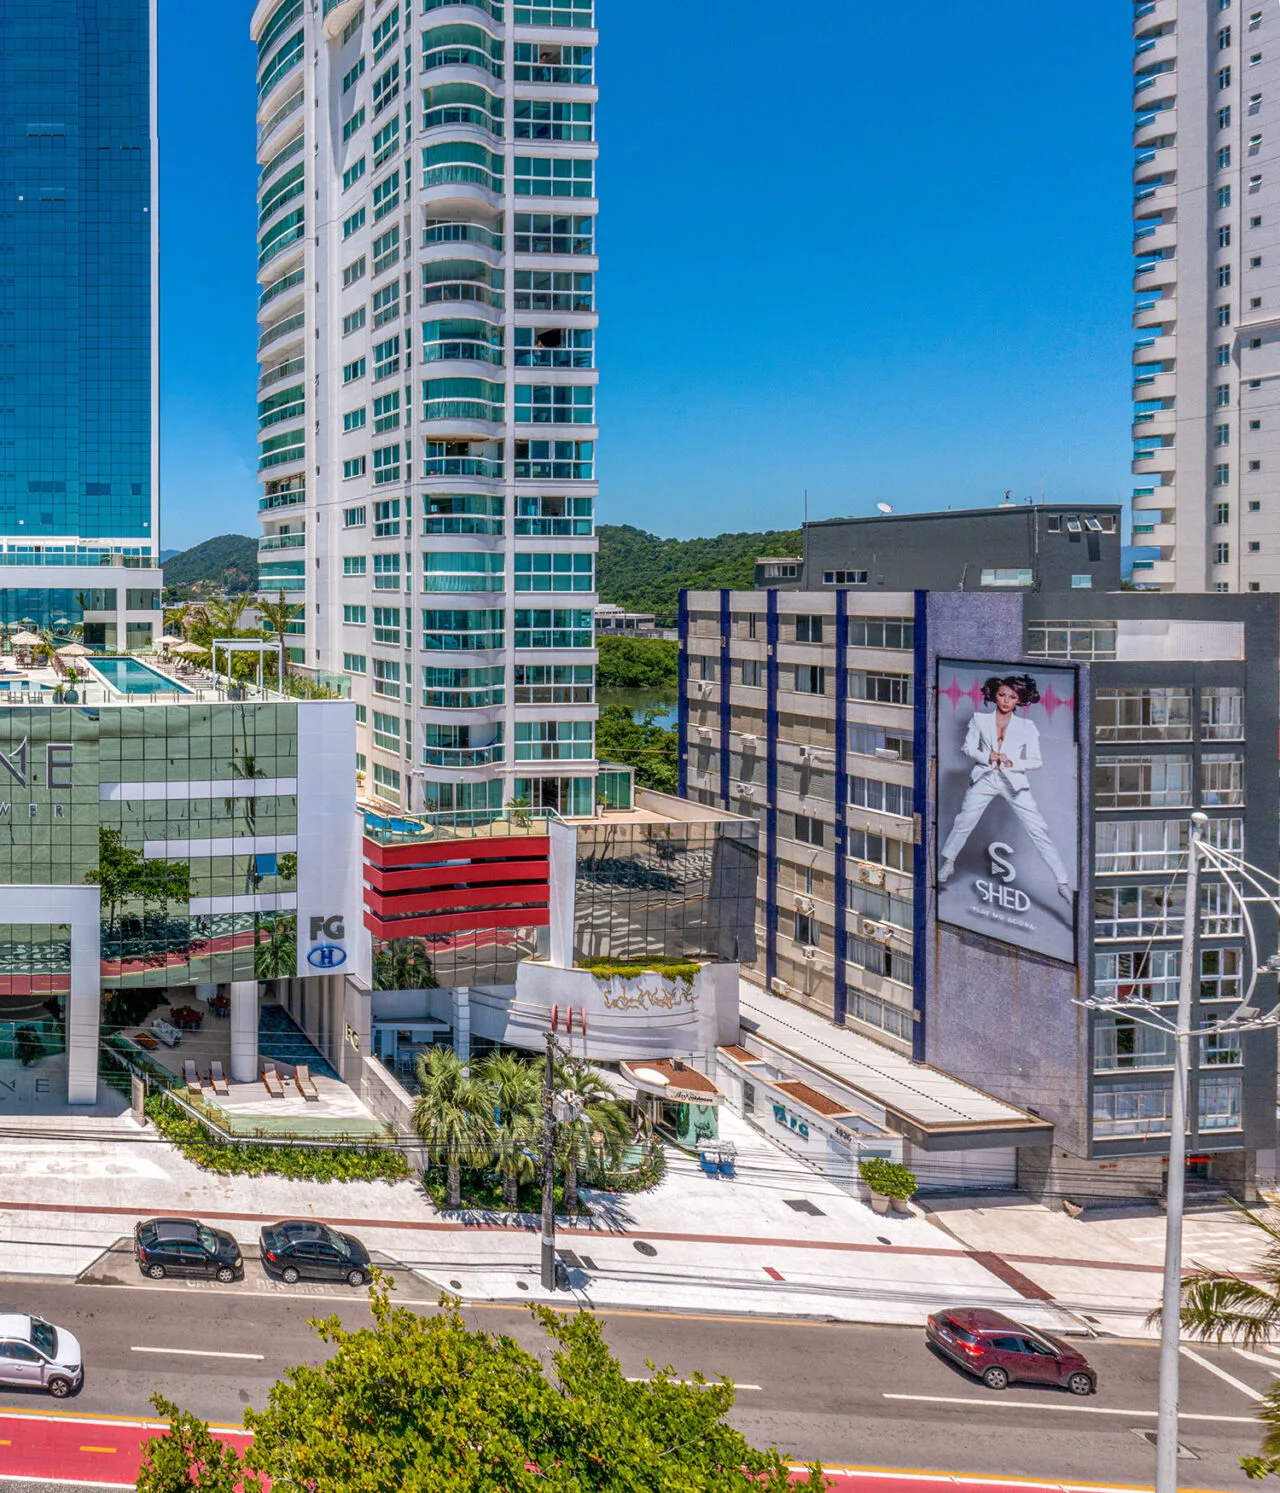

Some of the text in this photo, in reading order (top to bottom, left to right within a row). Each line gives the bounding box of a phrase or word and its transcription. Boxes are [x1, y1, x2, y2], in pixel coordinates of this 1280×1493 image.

[975, 879, 1032, 912] SHED
[309, 915, 345, 941] FG
[345, 1022, 360, 1053] FG
